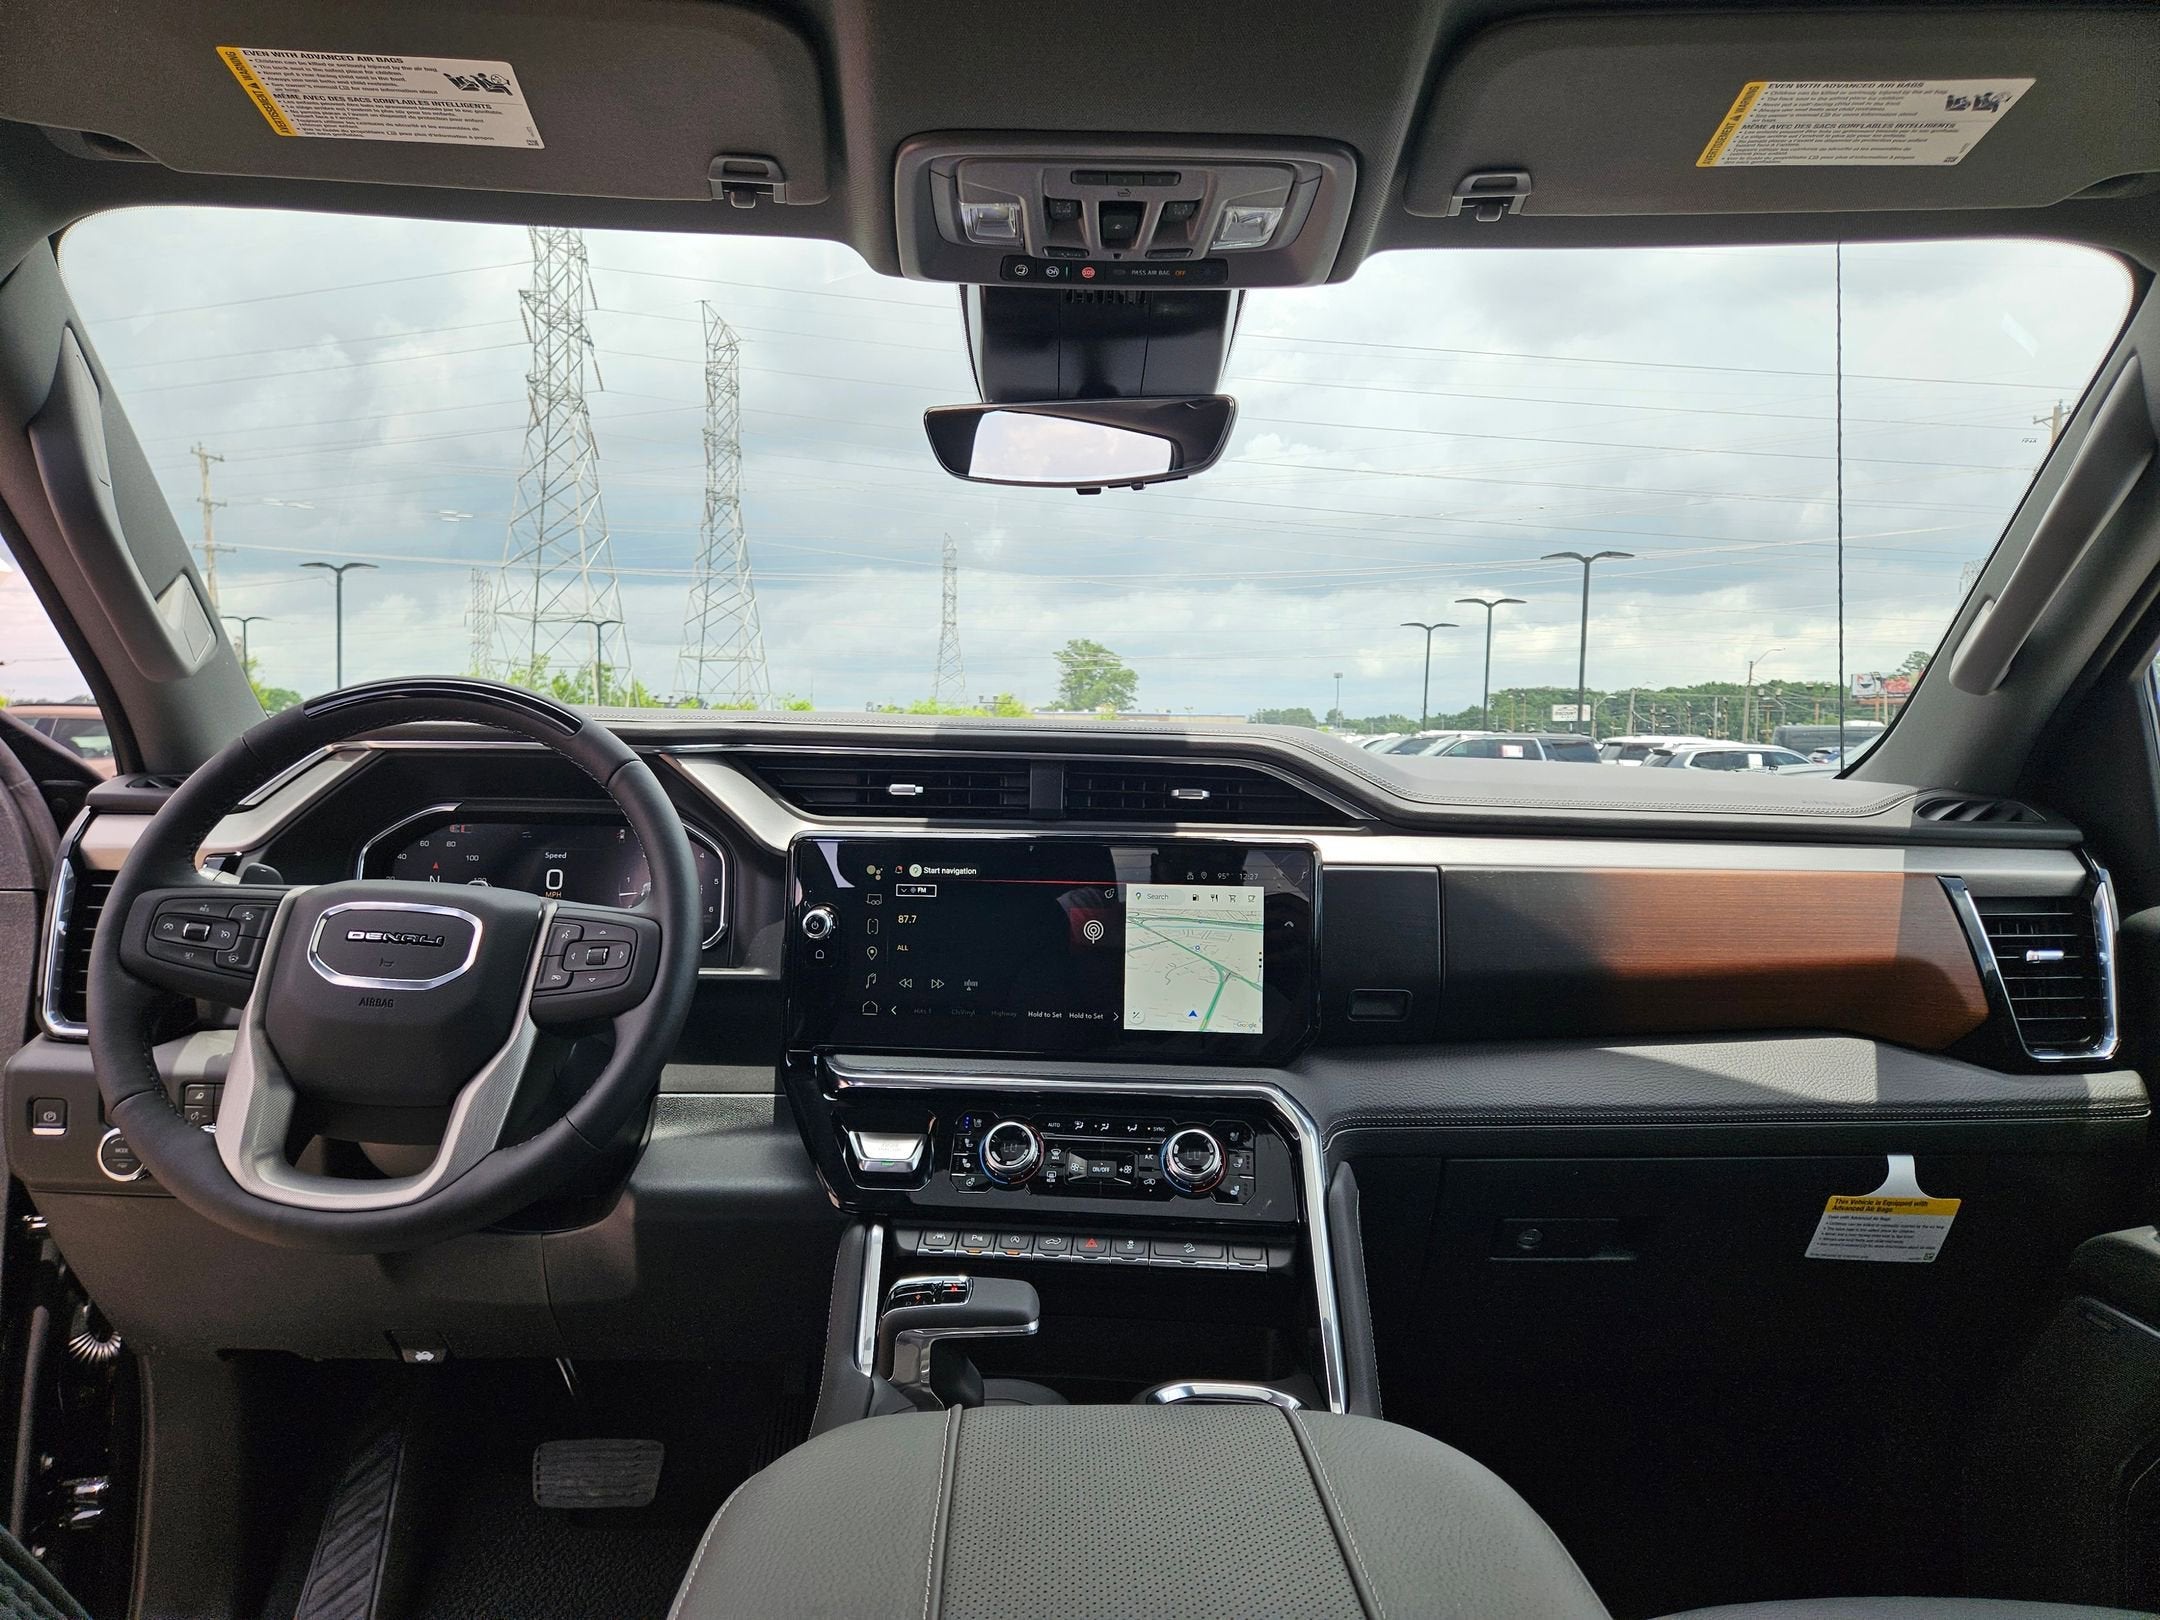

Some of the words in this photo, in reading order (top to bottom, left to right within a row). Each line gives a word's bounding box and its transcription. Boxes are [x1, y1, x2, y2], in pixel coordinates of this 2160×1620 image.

[271, 51, 298, 59] WITH
[300, 52, 354, 61] ADVANCED
[225, 51, 254, 81] WARNING
[373, 97, 430, 107] GONFLABLES
[431, 100, 493, 110] INTELLIGENTS
[545, 852, 567, 860] Speed
[923, 866, 940, 874] Start
[941, 868, 977, 876] navigation
[1239, 872, 1259, 880] 12:27
[546, 868, 564, 890] 0
[897, 914, 917, 924] 87.7
[347, 930, 444, 945] DENALI
[359, 997, 394, 1008] AIRBAG
[1052, 1011, 1062, 1019] Set
[1093, 1012, 1104, 1020] Set
